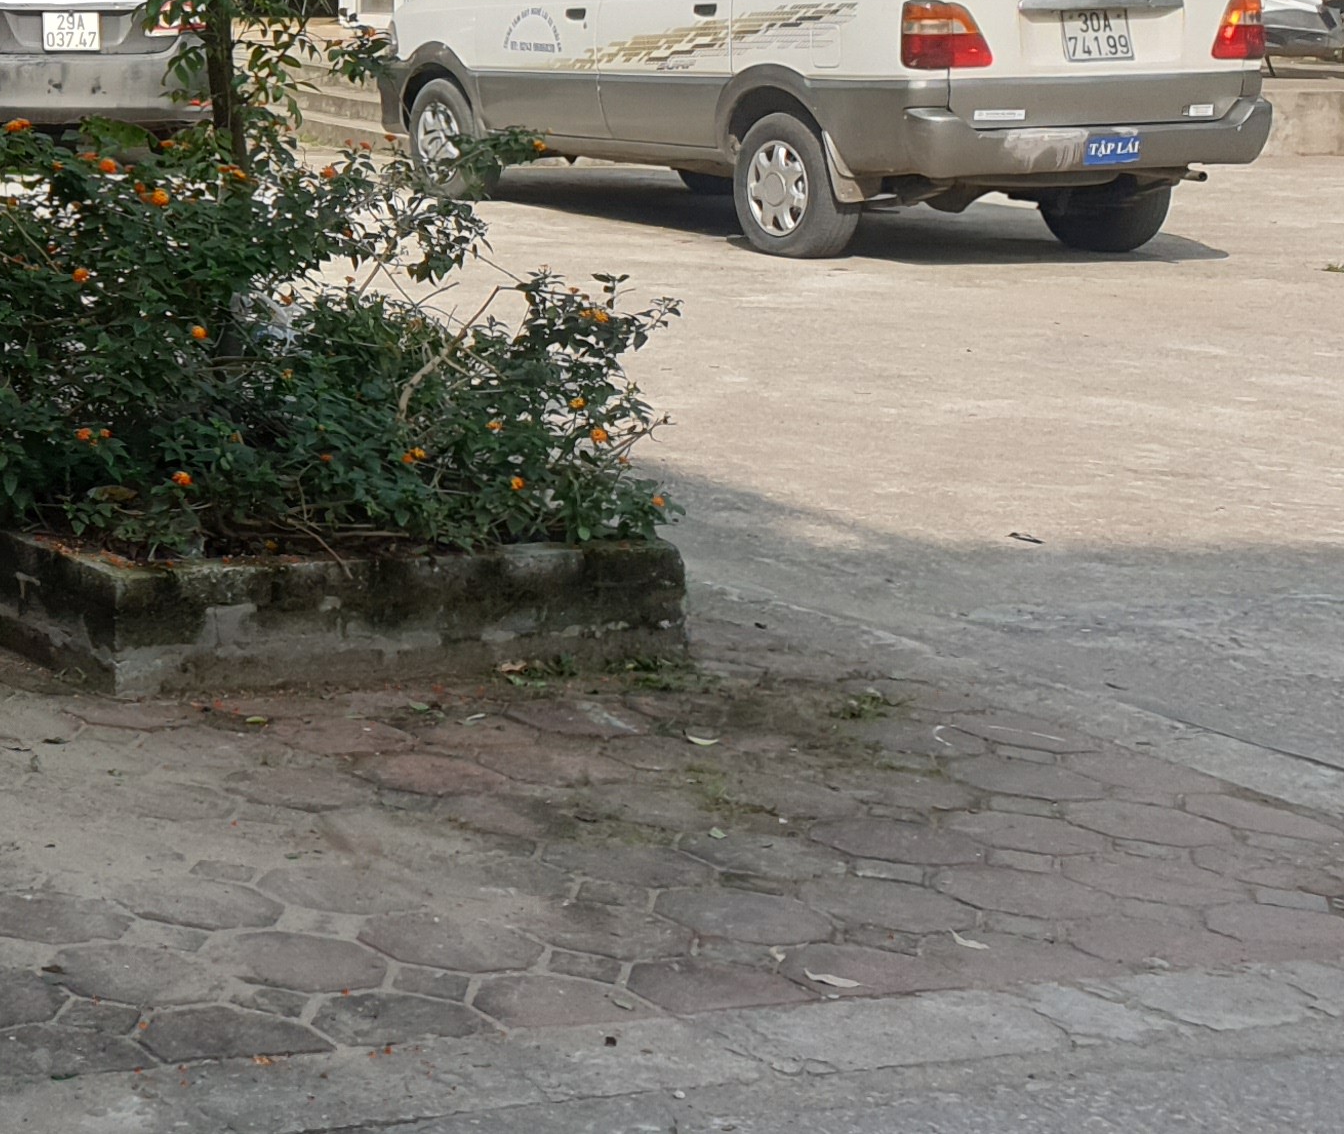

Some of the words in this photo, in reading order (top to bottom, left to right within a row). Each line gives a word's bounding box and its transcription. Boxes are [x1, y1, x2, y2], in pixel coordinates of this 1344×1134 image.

[57, 14, 85, 30] 29A
[1079, 12, 1112, 32] 30A
[46, 31, 97, 48] 037.47
[1068, 34, 1130, 58] 741.99
[1089, 140, 1114, 158] TẬP
[1116, 137, 1140, 155] LÁI
